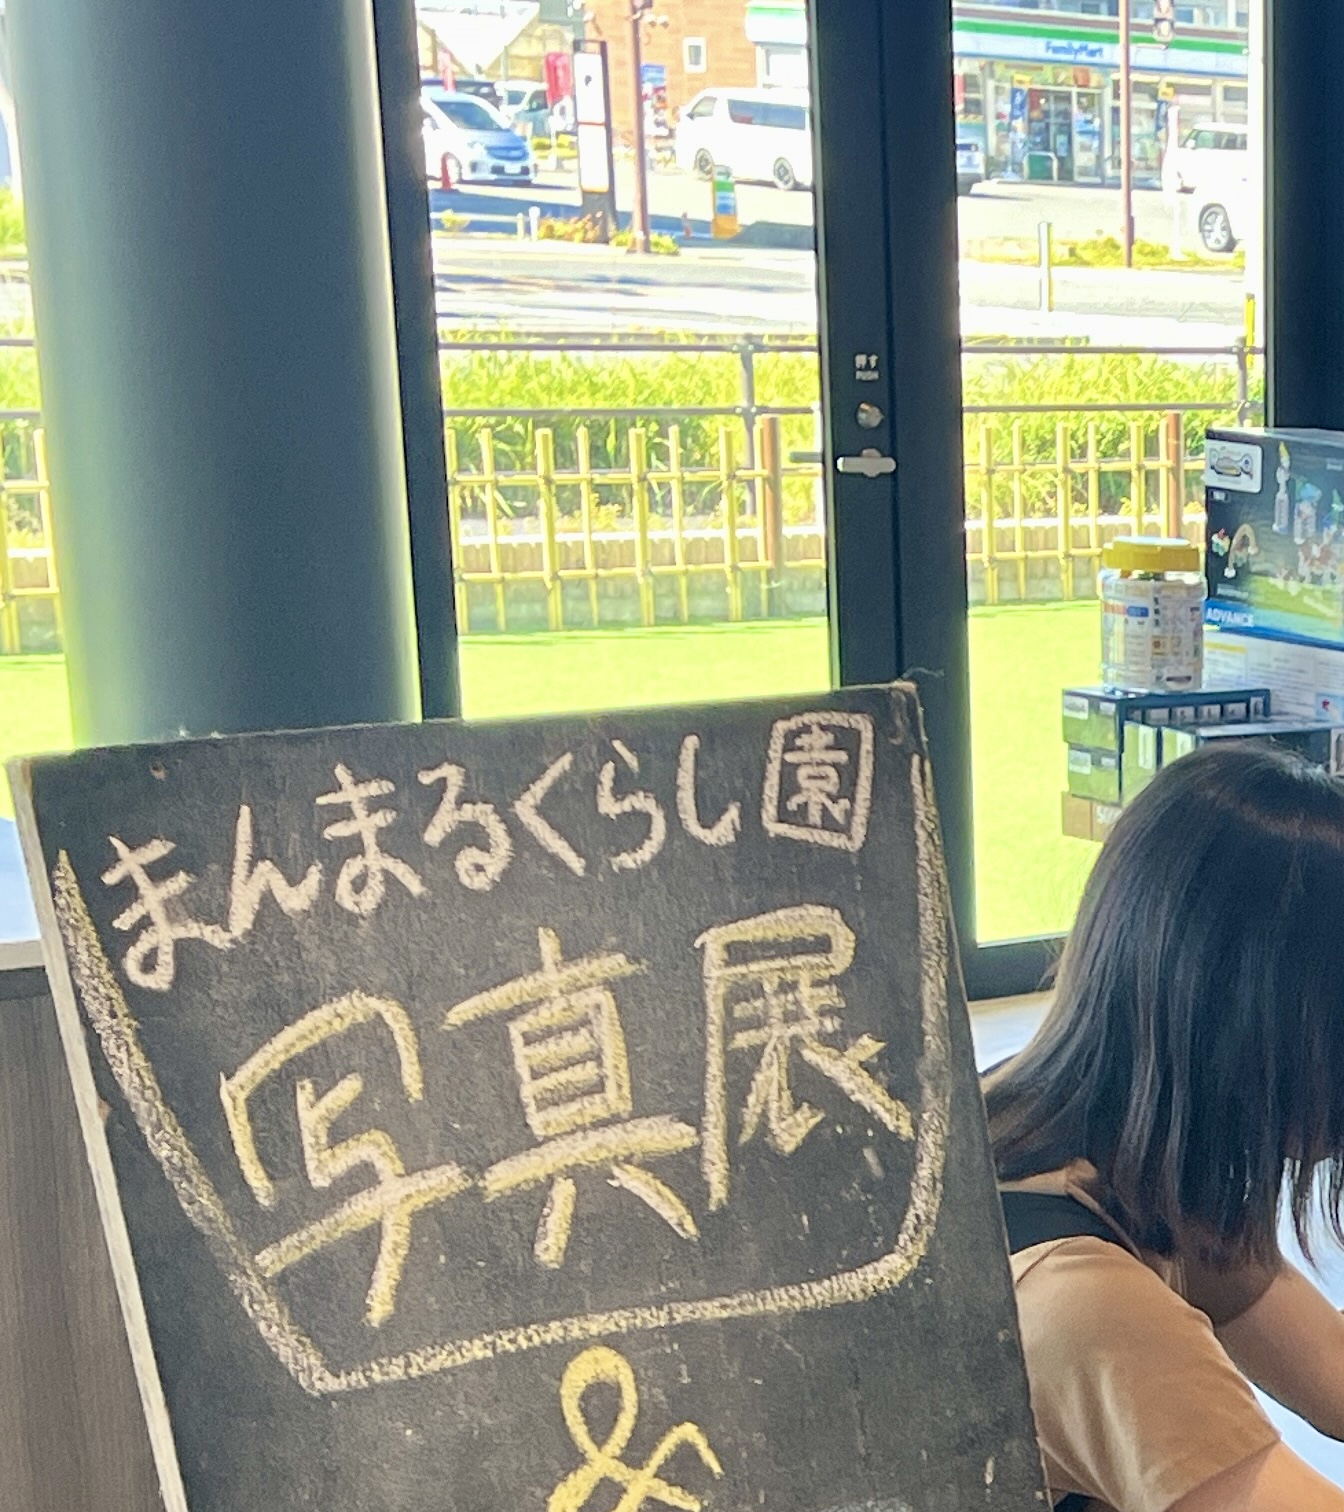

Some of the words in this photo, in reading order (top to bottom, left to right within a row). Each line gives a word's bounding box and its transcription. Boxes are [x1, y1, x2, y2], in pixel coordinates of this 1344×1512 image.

[1206, 607, 1255, 626] ADVANCE
[101, 710, 874, 990] まんまるくらし園
[219, 904, 914, 1326] 写真展
